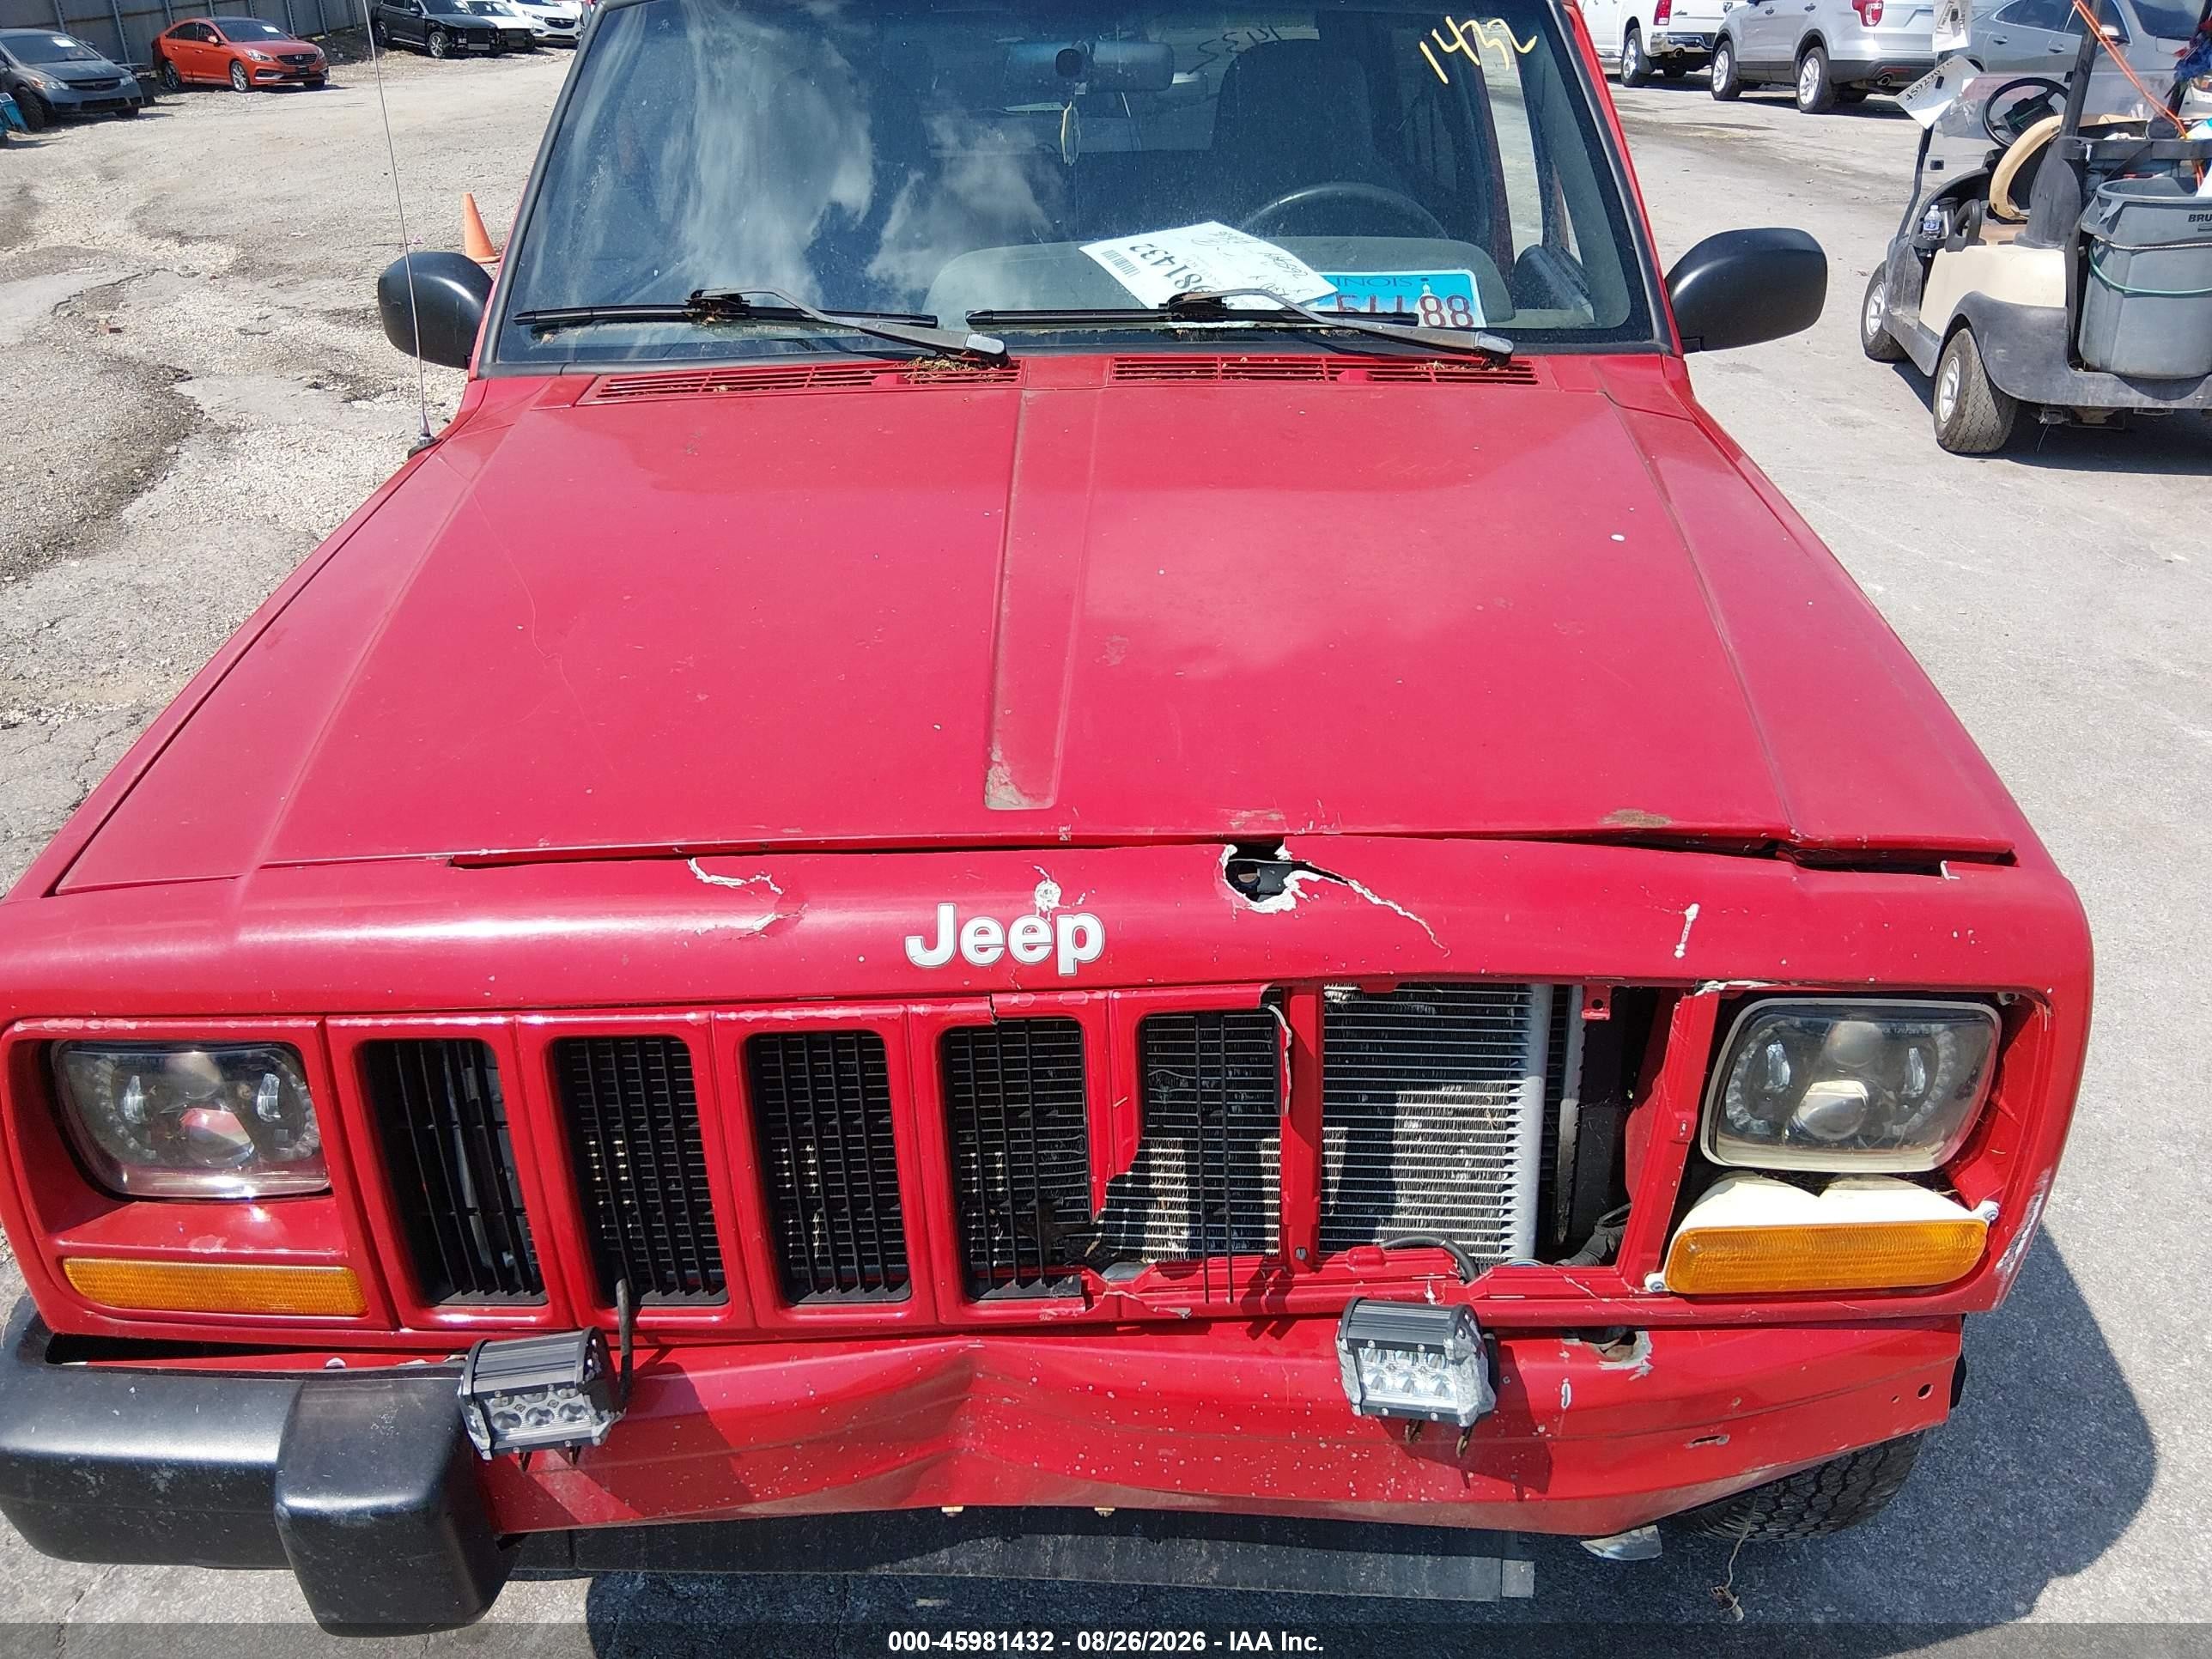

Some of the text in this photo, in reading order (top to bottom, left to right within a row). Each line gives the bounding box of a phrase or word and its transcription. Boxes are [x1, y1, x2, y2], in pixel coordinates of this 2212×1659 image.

[1419, 15, 1538, 84] 1432
[2188, 213, 2212, 222] BRU
[1128, 243, 1217, 293] 81432
[1336, 276, 1413, 288] INOIS
[905, 902, 1105, 975] Jeep
